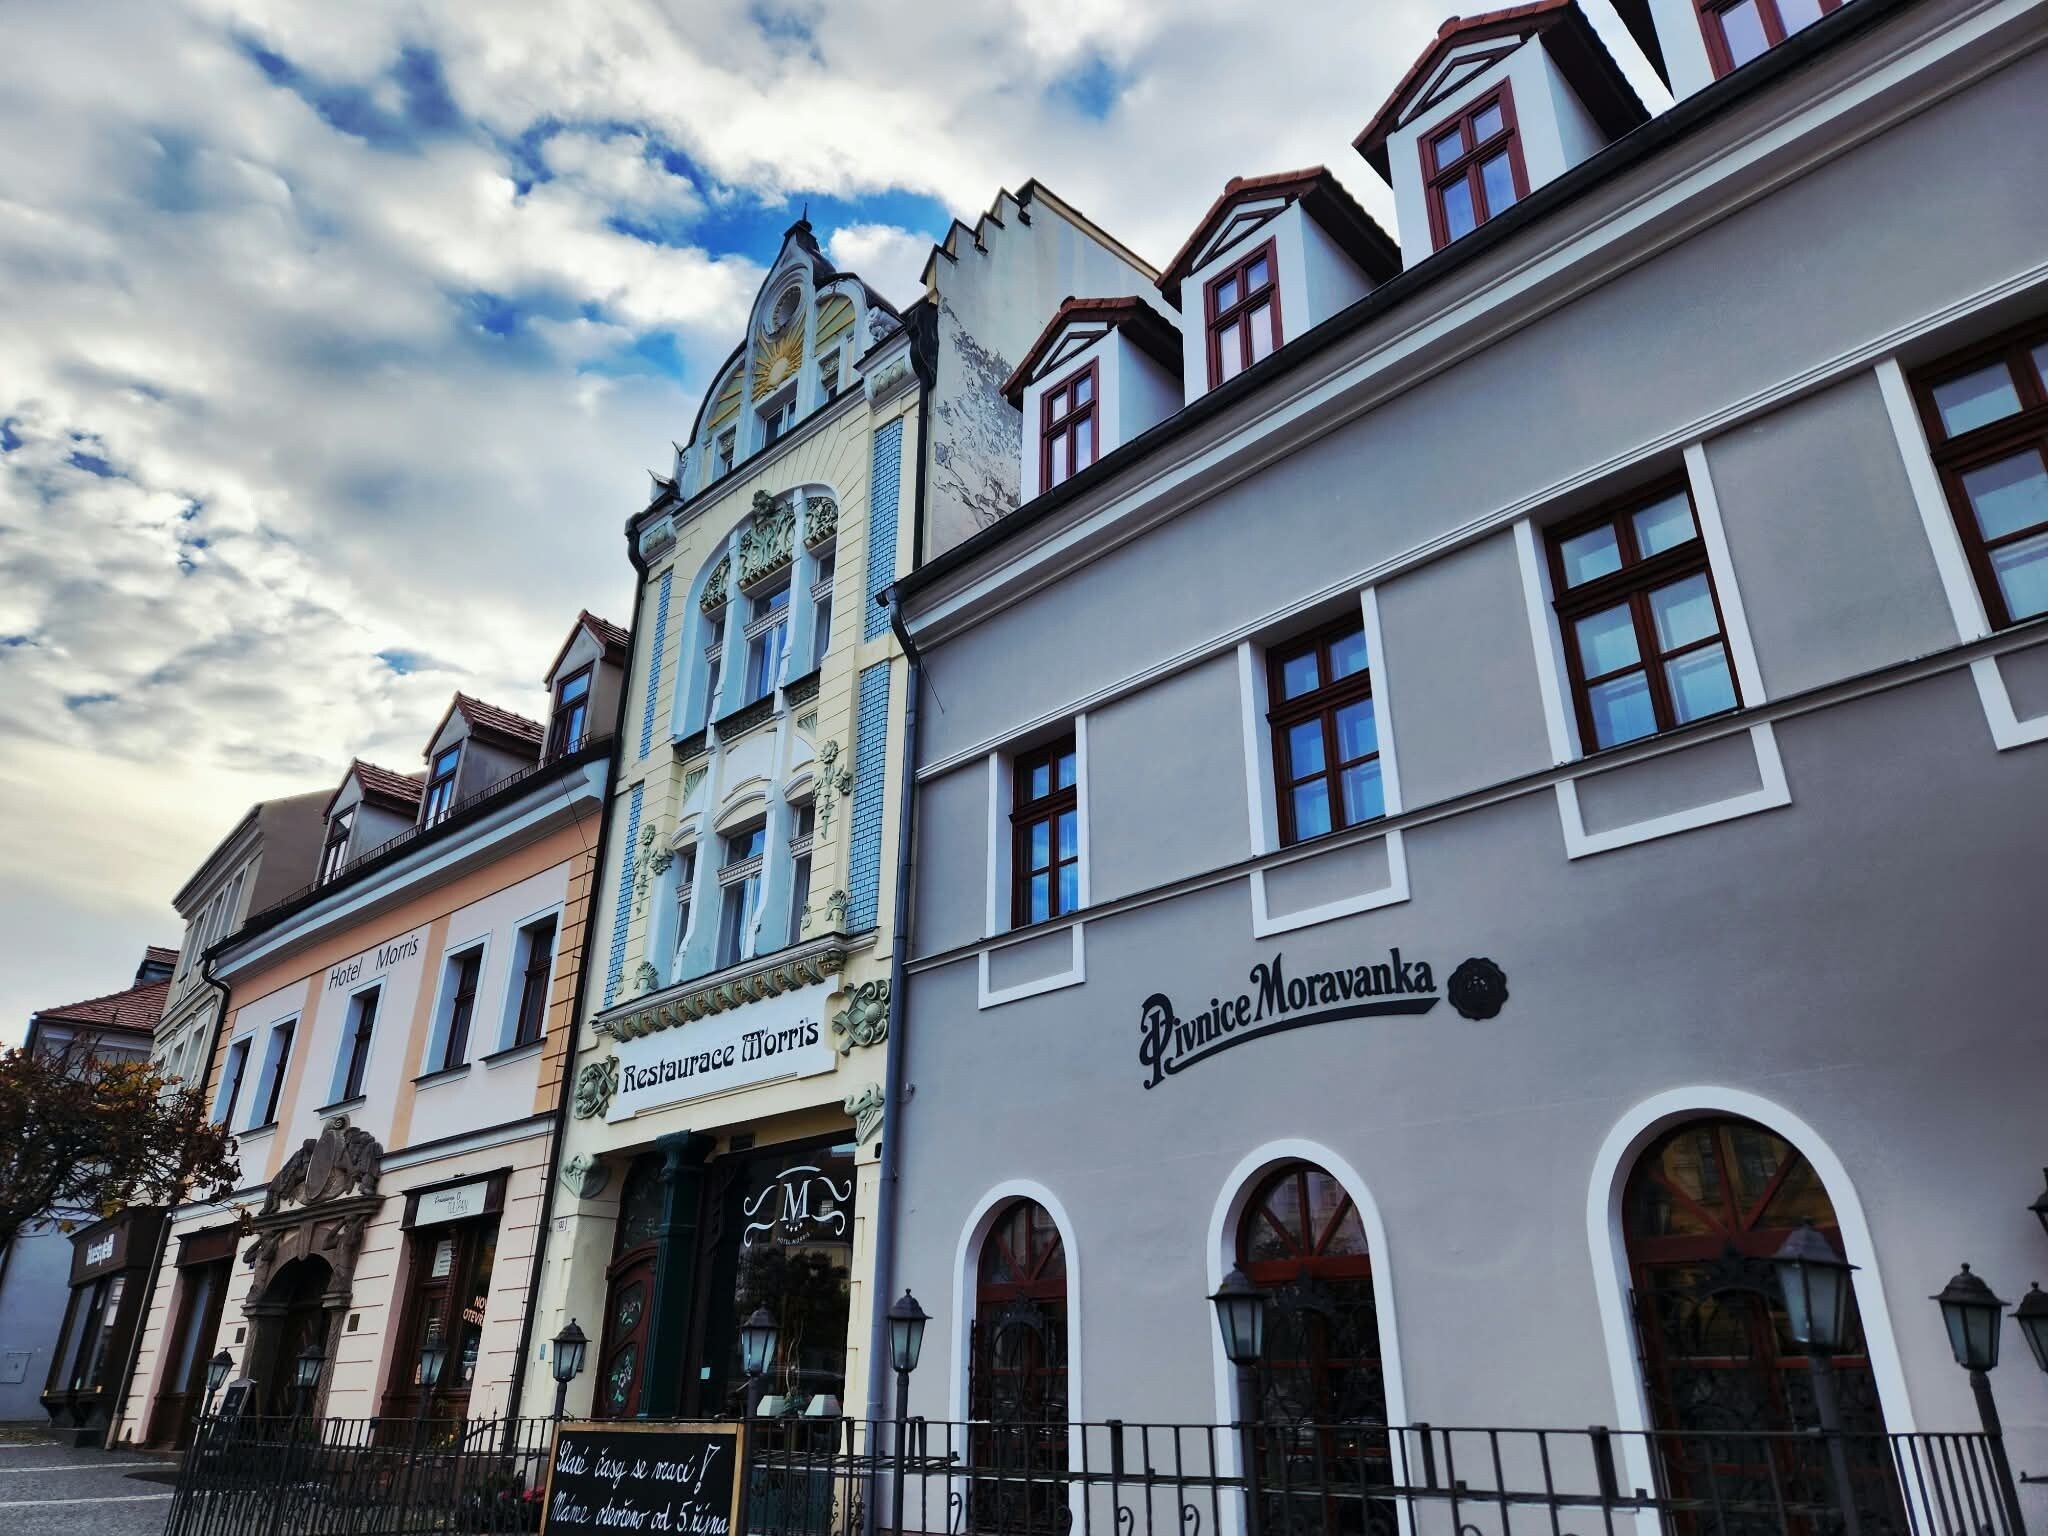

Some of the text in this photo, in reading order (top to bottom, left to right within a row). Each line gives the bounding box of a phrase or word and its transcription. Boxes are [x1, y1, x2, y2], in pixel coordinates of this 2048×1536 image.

[329, 935, 419, 991] Hotel Morris
[1139, 947, 1437, 1090] Pivnice Moravanka
[622, 1019, 819, 1094] Restaurace Morris
[780, 1179, 812, 1222] M
[594, 1446, 628, 1490] časy
[630, 1458, 649, 1480] se
[551, 1490, 592, 1524] Máme
[595, 1496, 651, 1530] otevřeno
[650, 1501, 672, 1531] od
